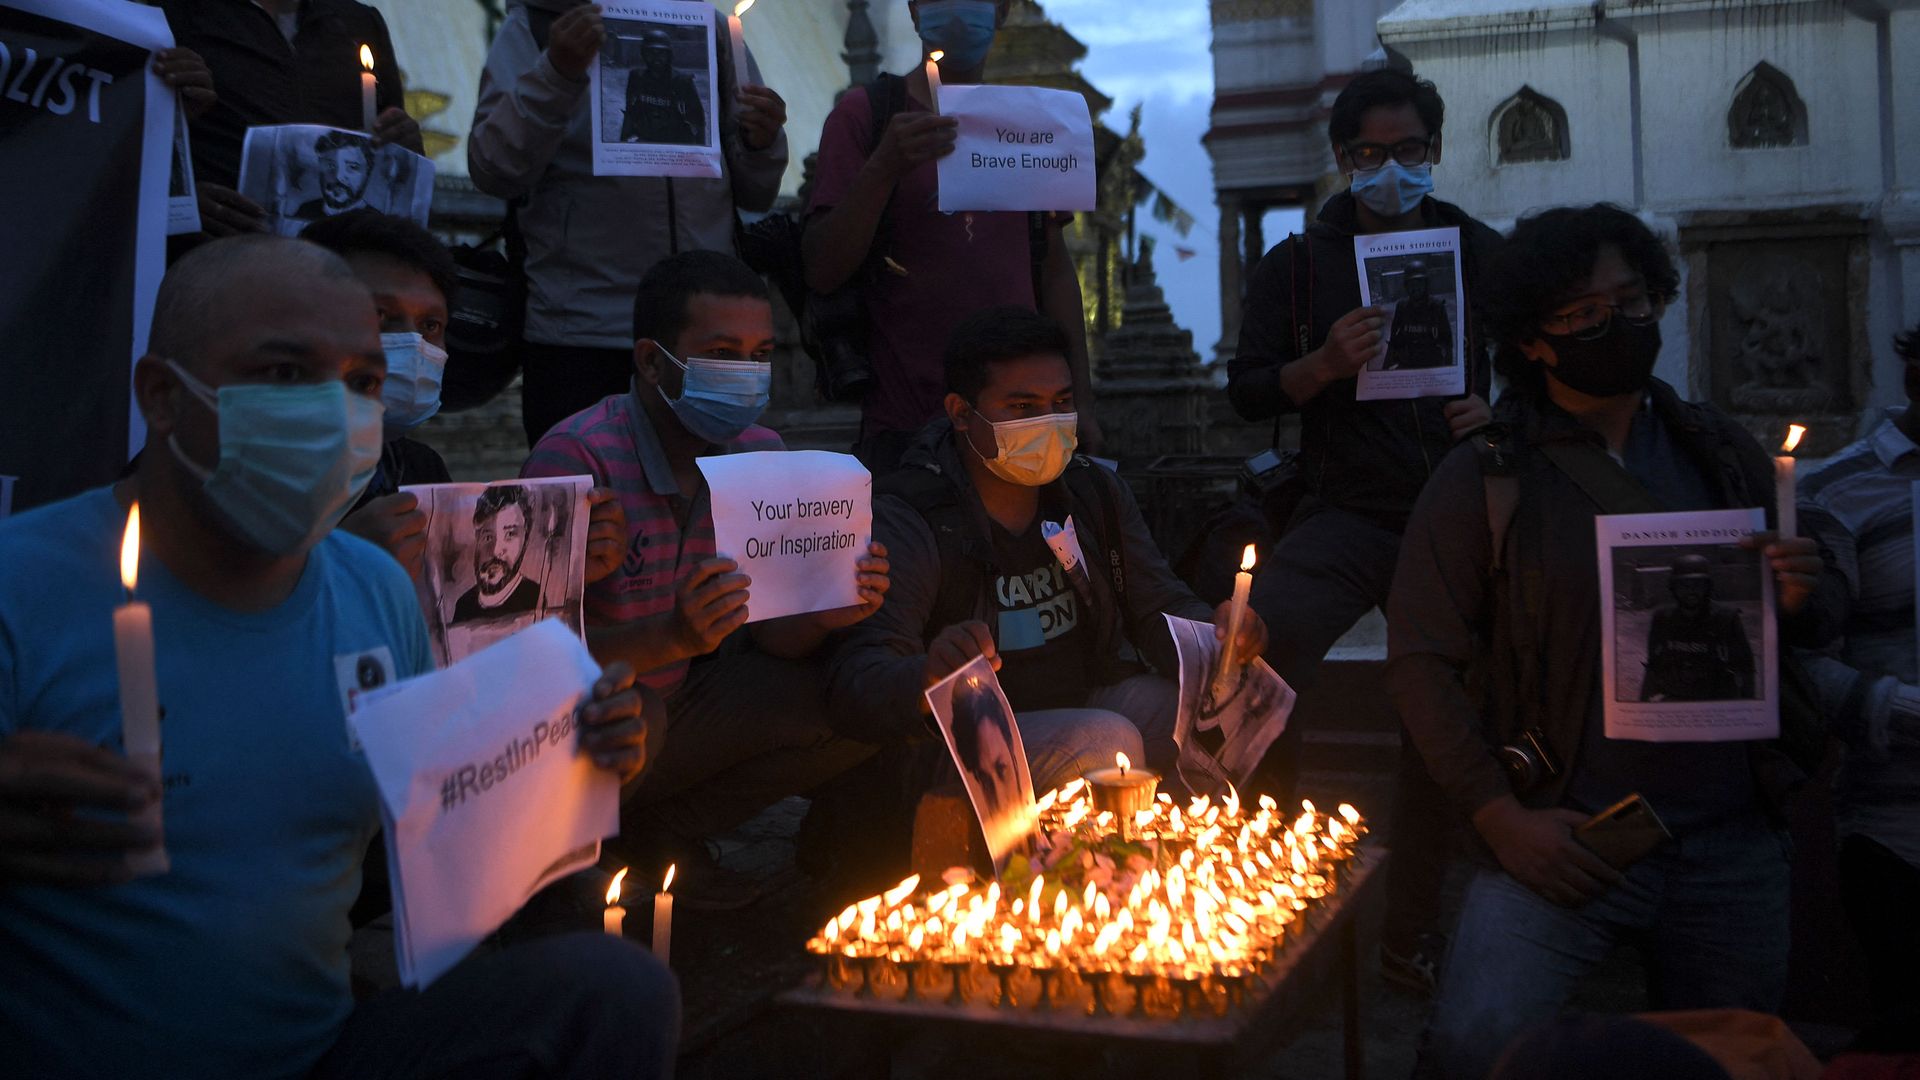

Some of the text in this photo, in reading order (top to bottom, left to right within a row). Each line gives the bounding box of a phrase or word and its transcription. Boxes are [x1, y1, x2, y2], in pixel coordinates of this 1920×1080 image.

[608, 7, 704, 21] DANISH SIDDIQUI
[995, 128, 1054, 144] You are
[971, 153, 1078, 173] Brave Enough
[1369, 240, 1452, 253] DANISH SIDDIQUI
[751, 497, 854, 521] Your bravery
[1621, 529, 1678, 540] DANISH
[746, 529, 856, 559] Our Inspiration
